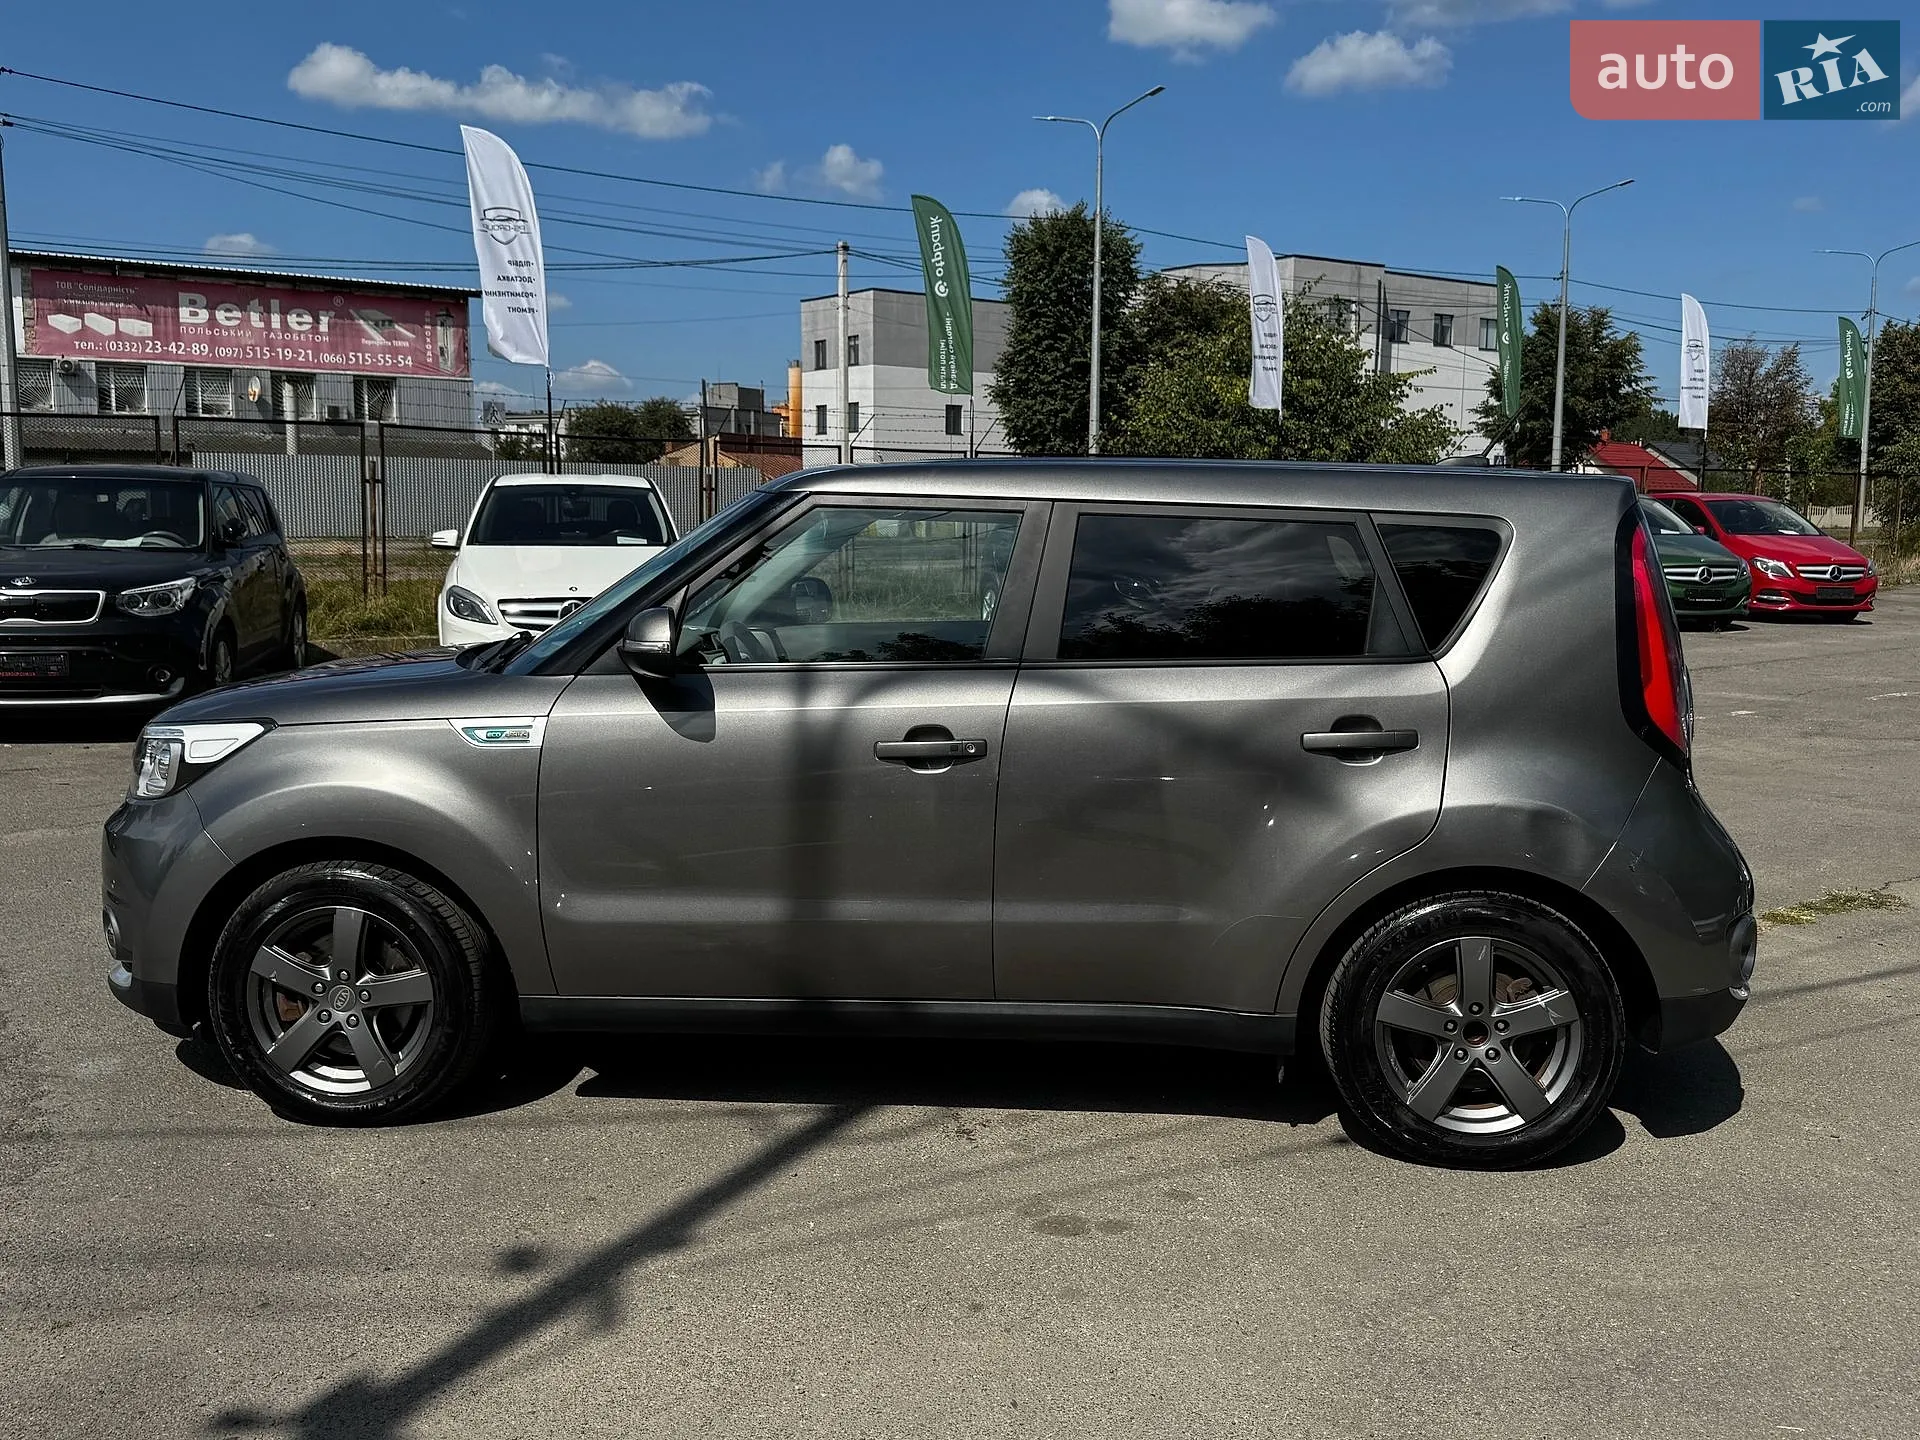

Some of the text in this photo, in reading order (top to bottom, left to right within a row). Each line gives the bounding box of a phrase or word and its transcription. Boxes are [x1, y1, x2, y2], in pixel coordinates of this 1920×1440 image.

[178, 292, 335, 334] Betler
[179, 325, 330, 343] ПОЛЬСЬКИЙ ГАЗОБЕТОН
[73, 340, 413, 368] тел.: (0332) 23-42-89, (097) 515-19-21, (066) 515-55-54
